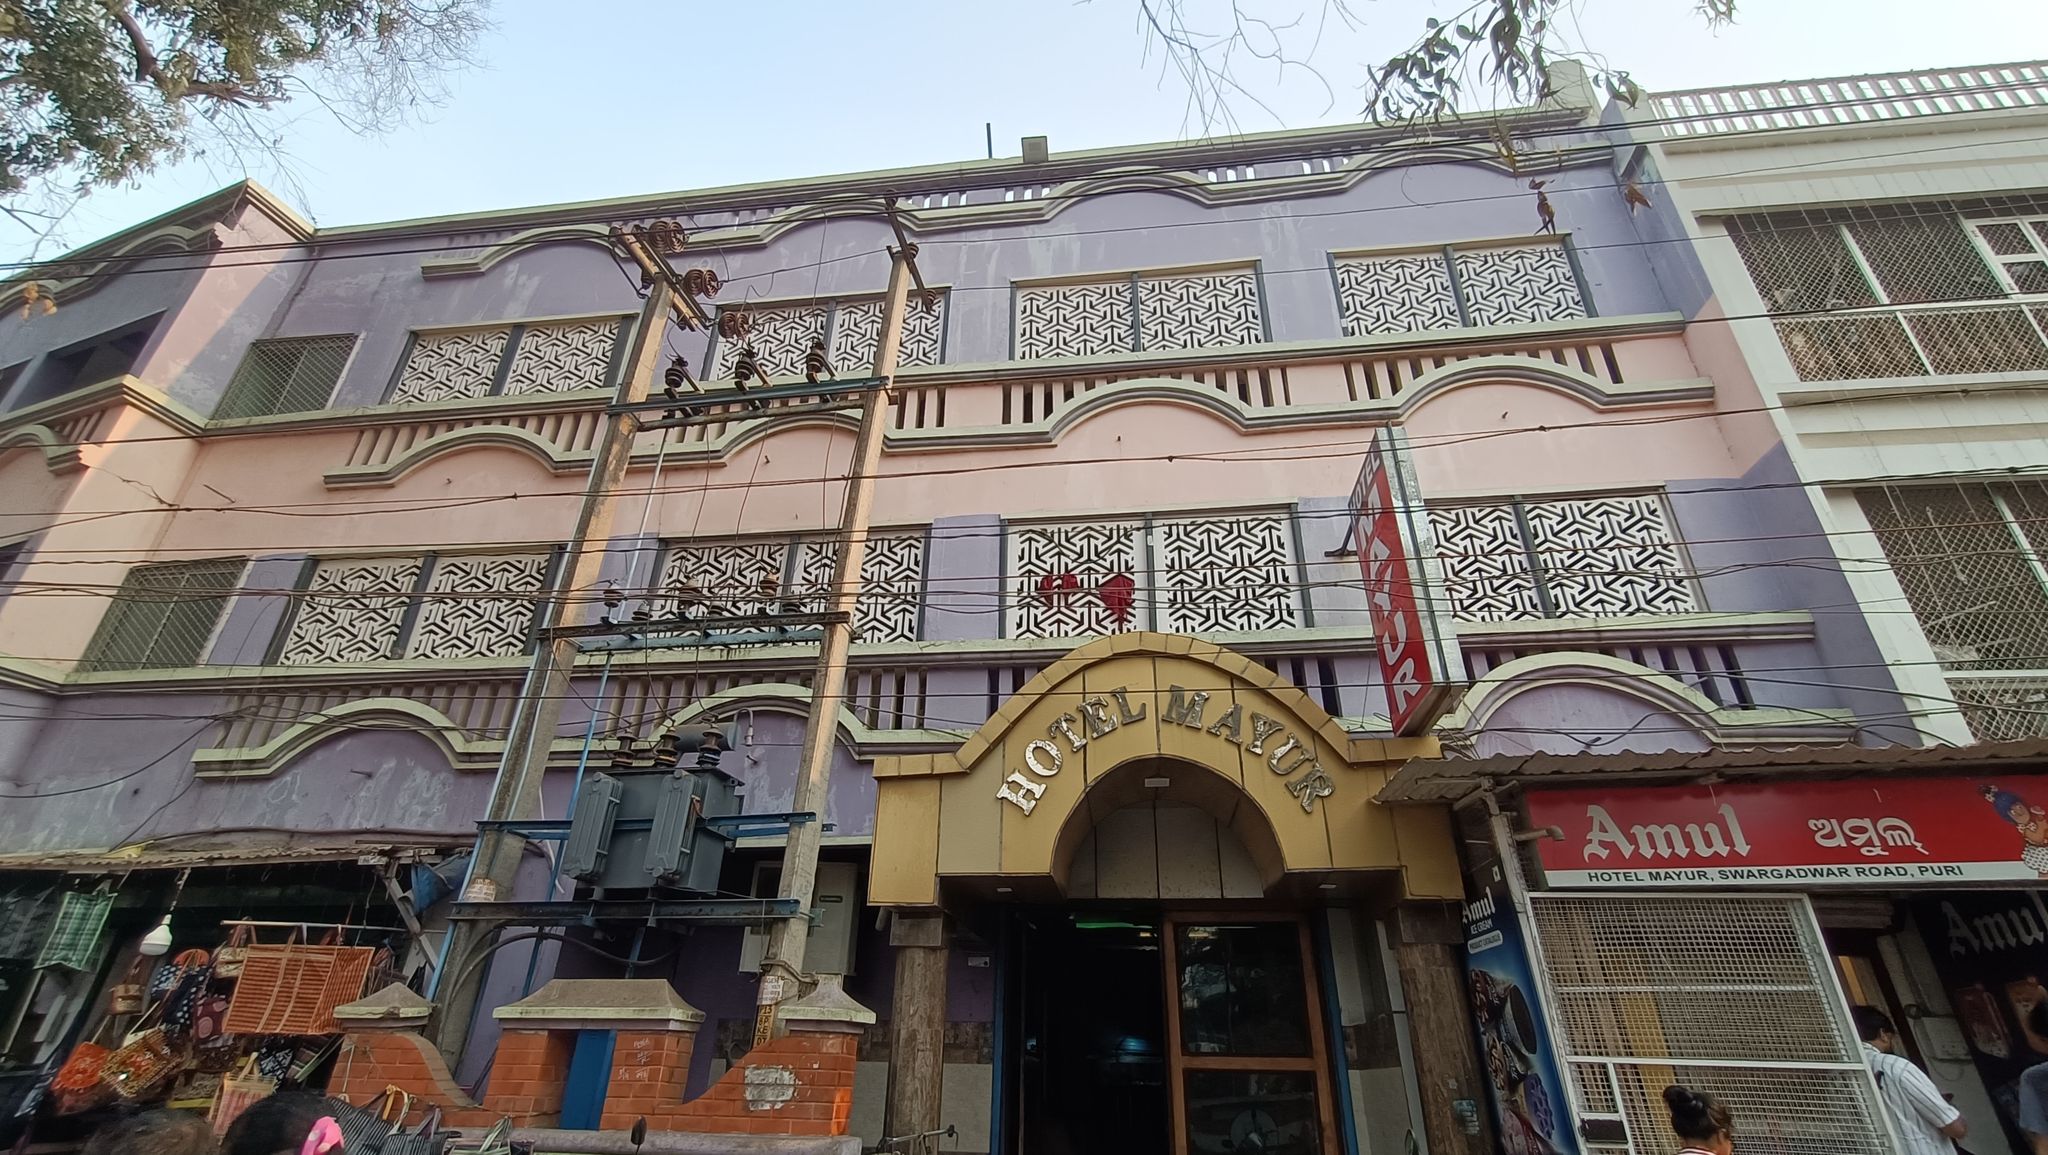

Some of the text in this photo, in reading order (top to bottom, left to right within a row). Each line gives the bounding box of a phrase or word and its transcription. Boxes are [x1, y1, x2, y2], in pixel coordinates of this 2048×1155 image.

[1350, 449, 1381, 528] HOTEL
[995, 684, 1336, 817] HOTEL MAYUR
[1583, 803, 1751, 863] Amul
[1587, 865, 1964, 882] HOTEL MAYUR, SWARGADWAR ROAD, PURI
[1462, 886, 1496, 924] Amul
